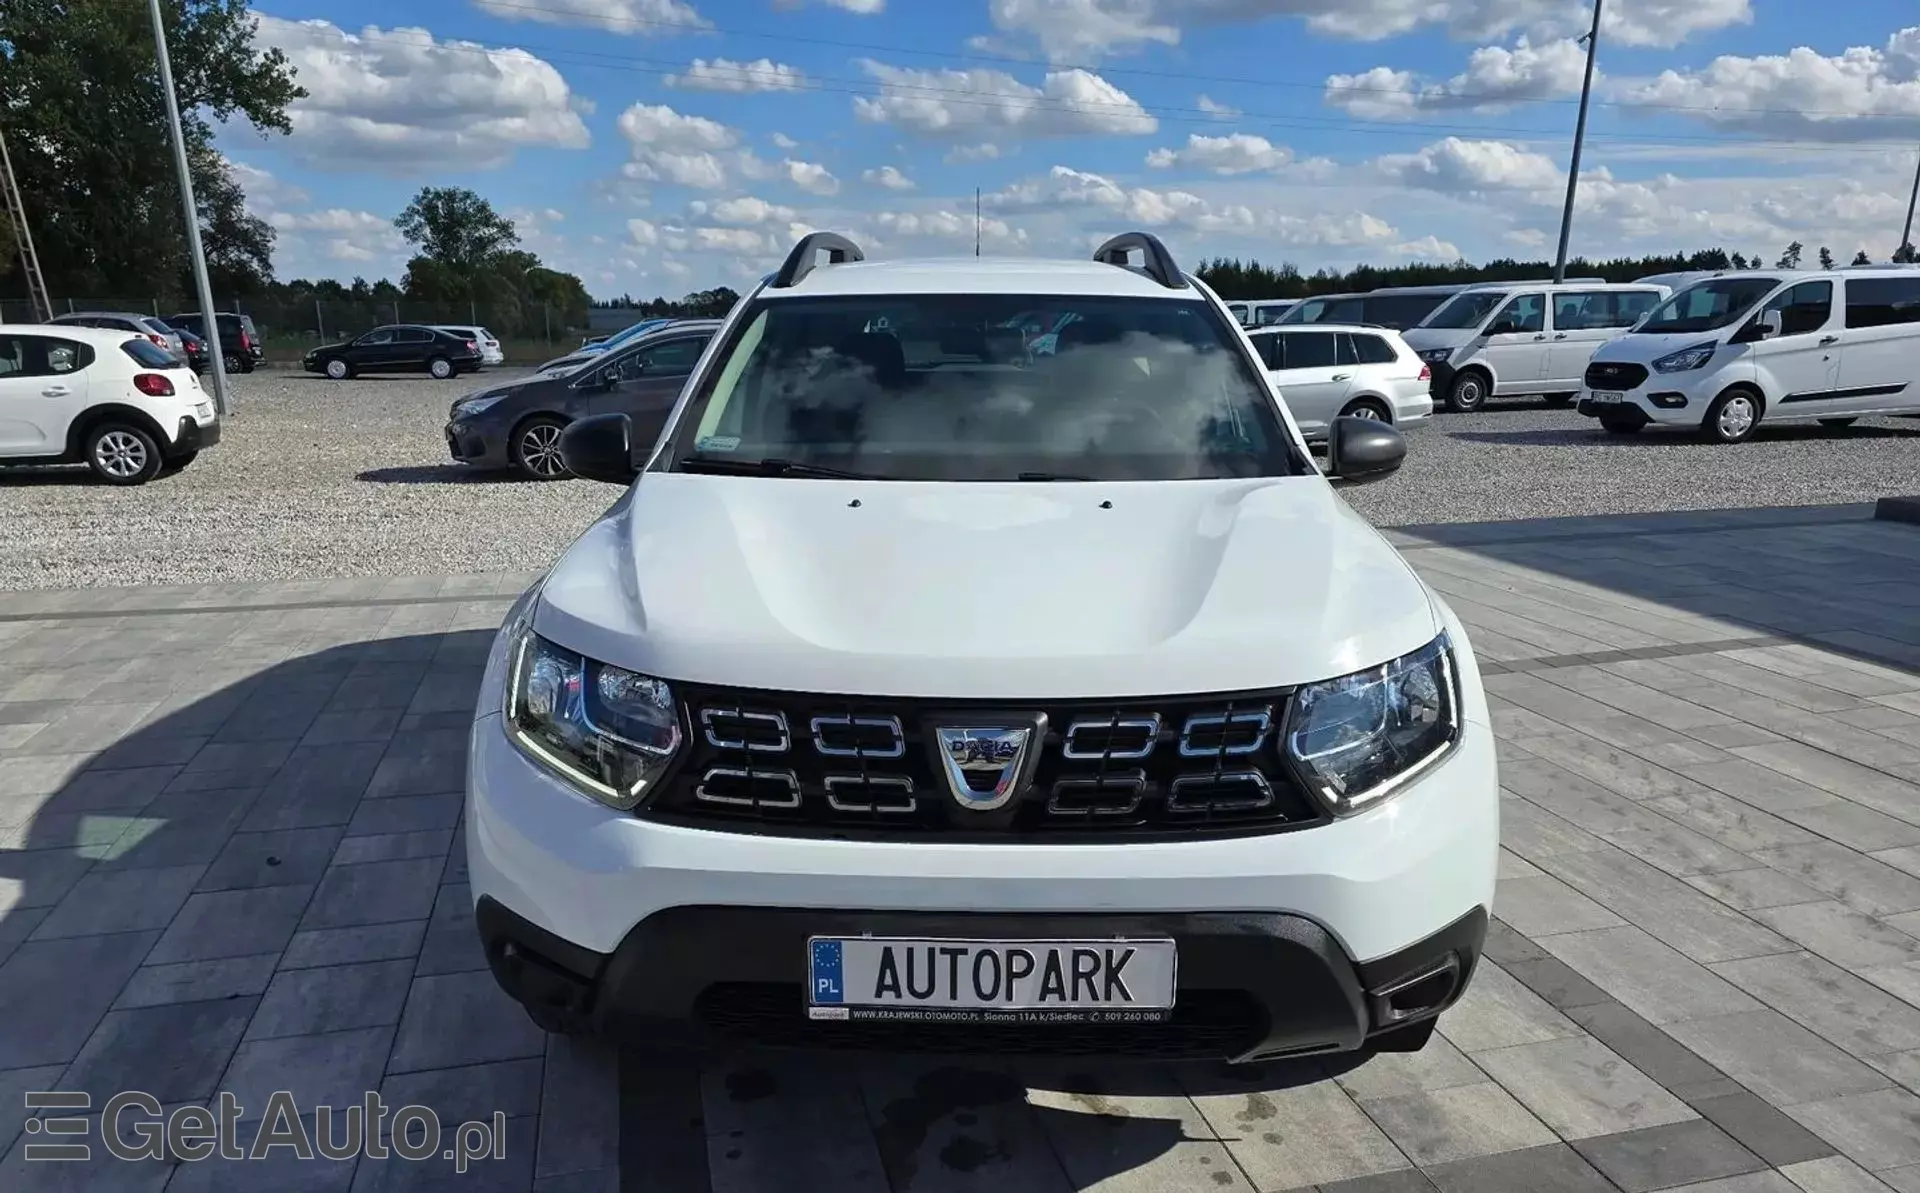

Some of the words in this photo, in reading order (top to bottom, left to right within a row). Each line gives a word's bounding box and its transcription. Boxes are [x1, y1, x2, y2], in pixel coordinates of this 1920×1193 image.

[952, 740, 1014, 753] DACIA
[874, 946, 1137, 1002] AUTOPARK
[818, 979, 839, 994] PL
[1019, 1012, 1037, 1021] 11A
